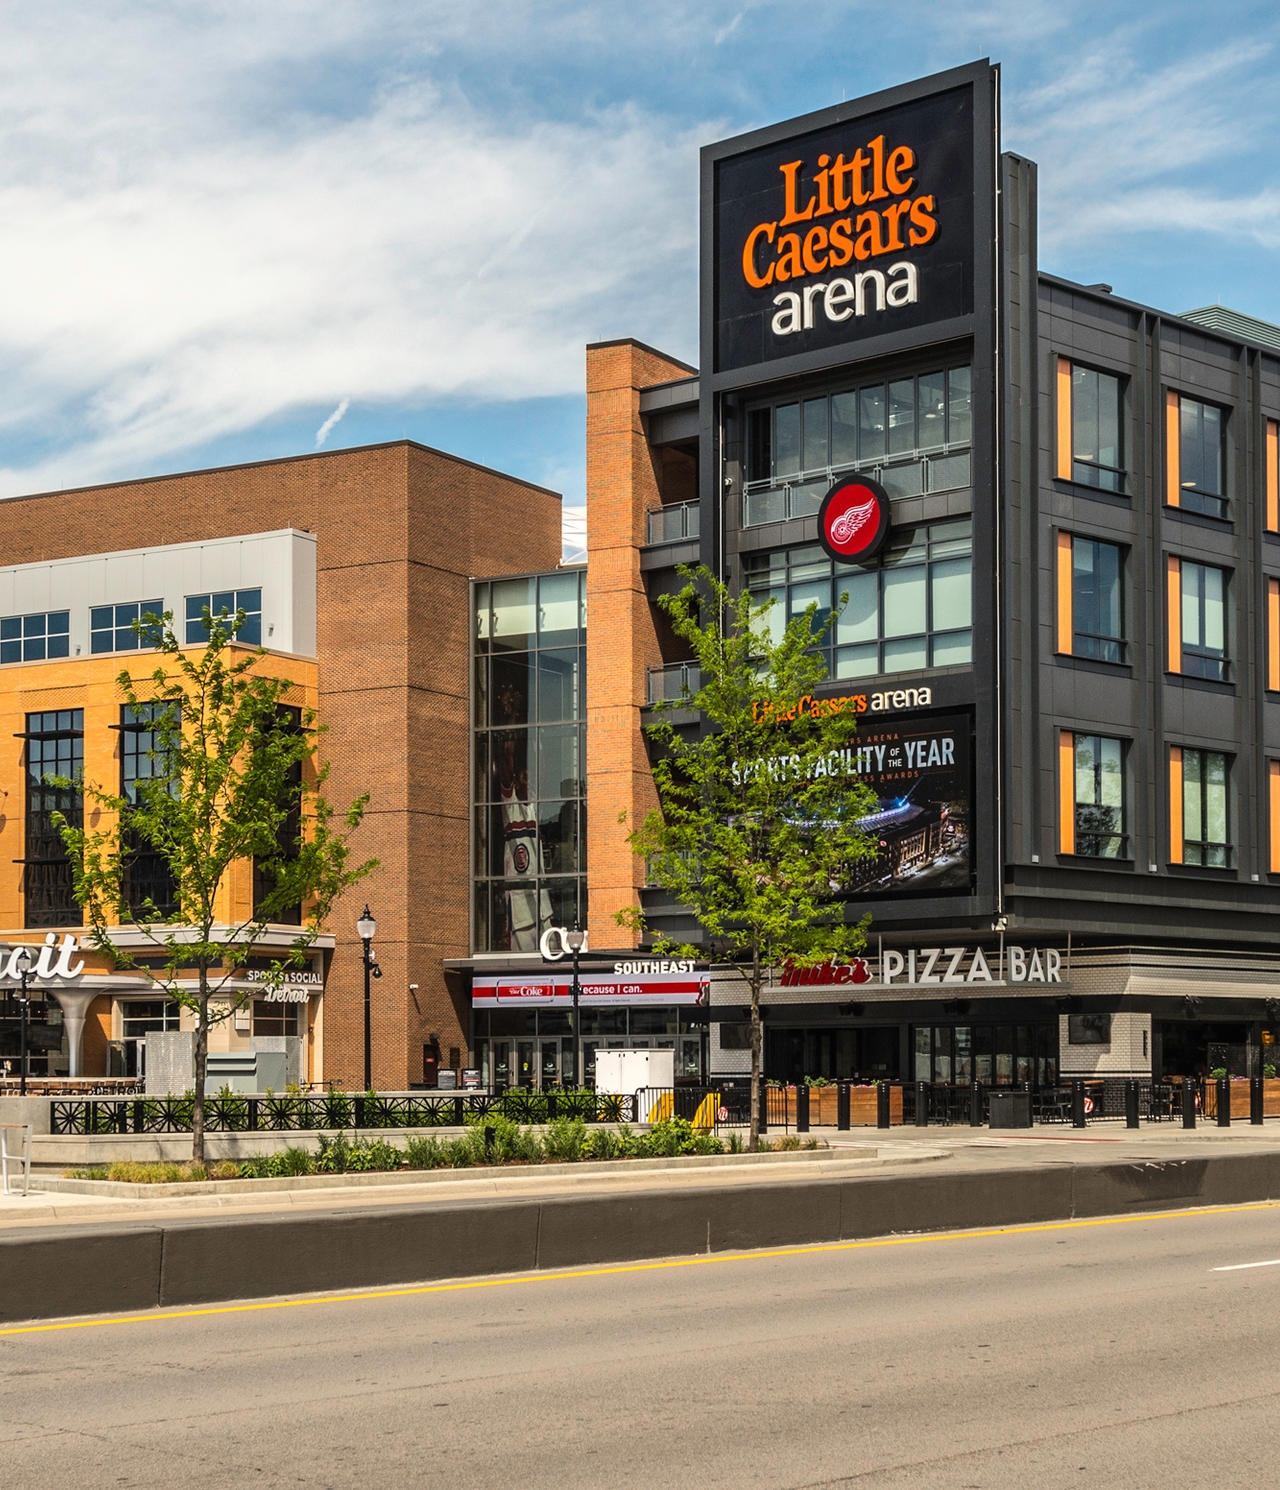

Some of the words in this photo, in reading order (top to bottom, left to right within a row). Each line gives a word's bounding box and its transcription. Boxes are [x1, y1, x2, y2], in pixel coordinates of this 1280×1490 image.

[778, 134, 915, 228] Little
[742, 193, 937, 289] Caesars
[770, 260, 919, 336] arena
[870, 686, 932, 711] arena
[867, 733, 900, 743] ARENA
[889, 748, 901, 757] OF
[904, 737, 955, 769] YEAR
[887, 759, 903, 767] THE
[880, 770, 920, 783] AWARDS
[614, 960, 697, 976] SOUTHEAST
[883, 947, 994, 985] PIZZA
[1007, 946, 1062, 983] BAR
[247, 970, 284, 981] SPORS
[290, 972, 323, 983] SOCIAL
[264, 983, 310, 1004] Detroit
[520, 986, 543, 997] Coke
[581, 985, 615, 995] ecause
[622, 984, 643, 994] can.
